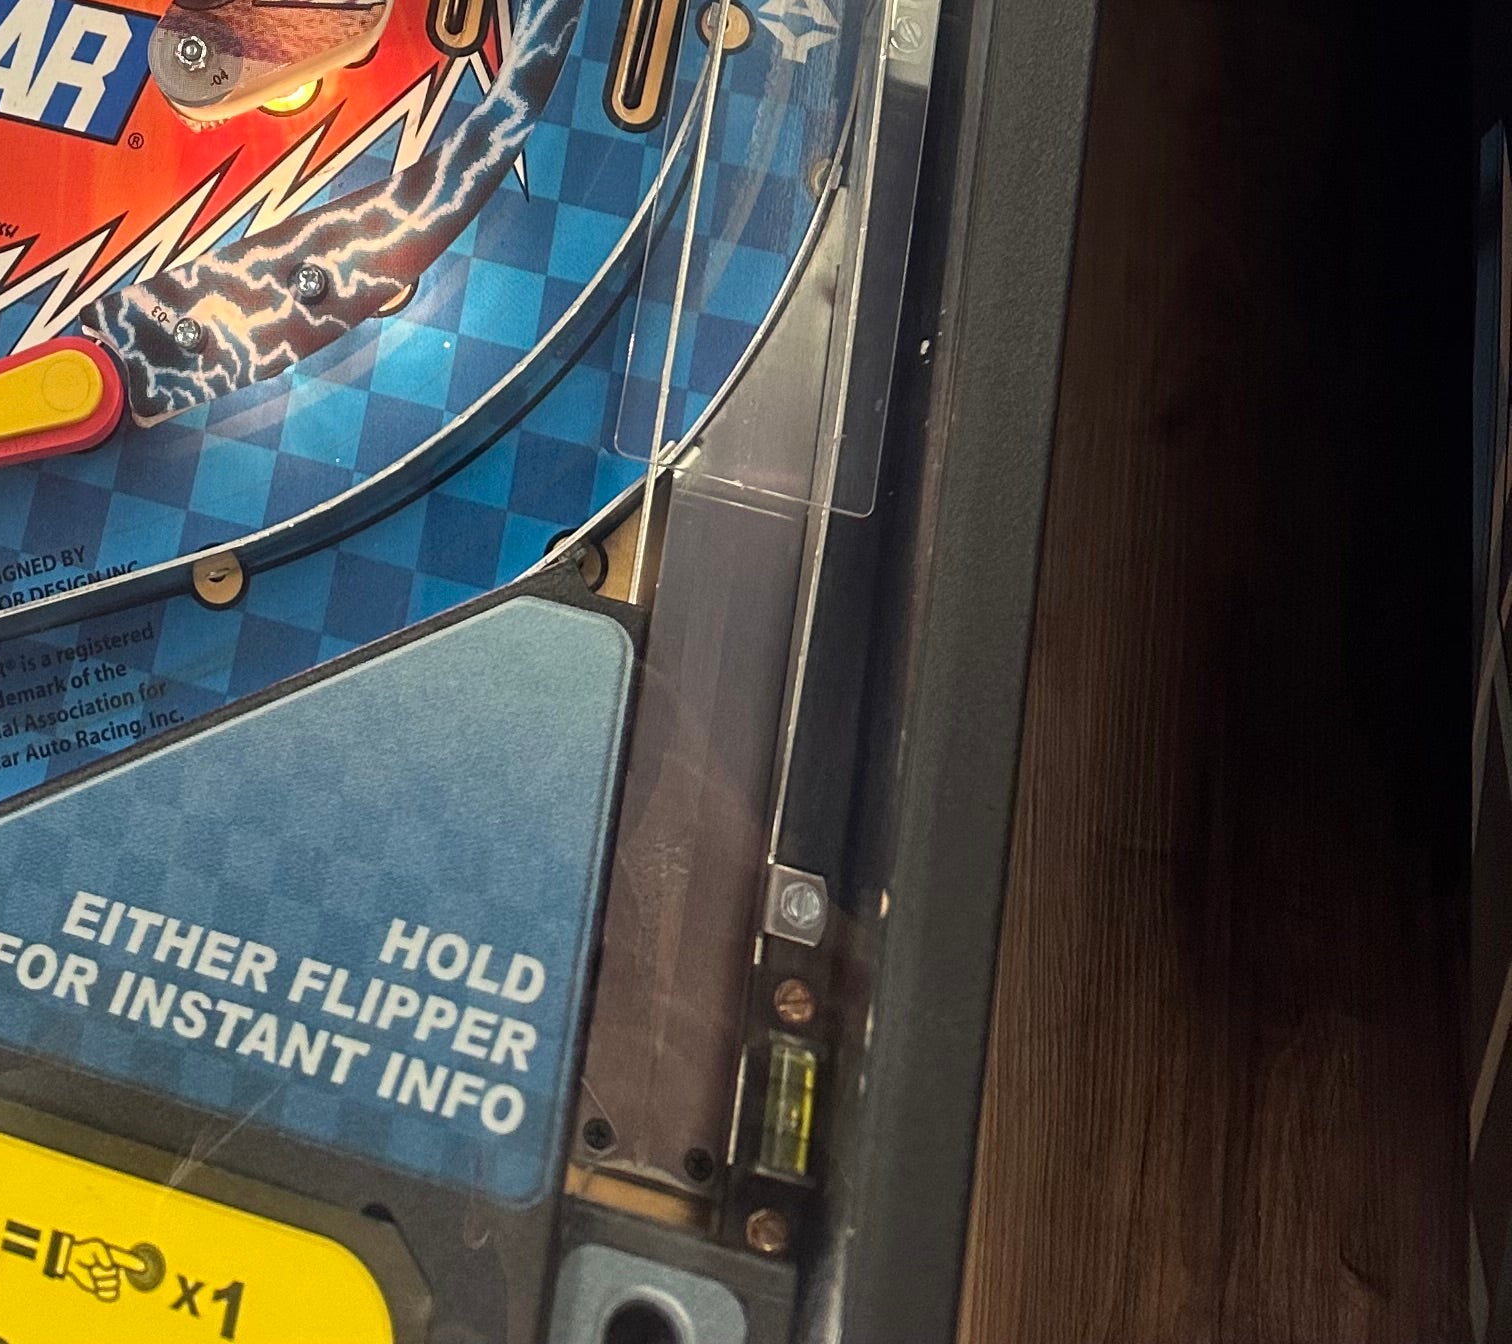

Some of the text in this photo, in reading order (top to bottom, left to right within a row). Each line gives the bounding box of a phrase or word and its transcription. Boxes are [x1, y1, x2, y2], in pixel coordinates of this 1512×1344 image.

[61, 545, 87, 567] BY
[20, 656, 37, 673] is
[40, 652, 52, 667] a
[55, 623, 155, 665] registered
[70, 669, 91, 690] of
[94, 662, 127, 683] the
[25, 691, 135, 733] Association
[139, 681, 168, 701] for
[25, 739, 72, 763] Auto
[76, 719, 147, 750] Racing,
[148, 709, 186, 728] Inc.
[61, 890, 538, 1072] EITHER FLIPPER
[377, 916, 546, 1005] HOLD
[106, 970, 371, 1087] INSTANT
[376, 1050, 527, 1136] INFO
